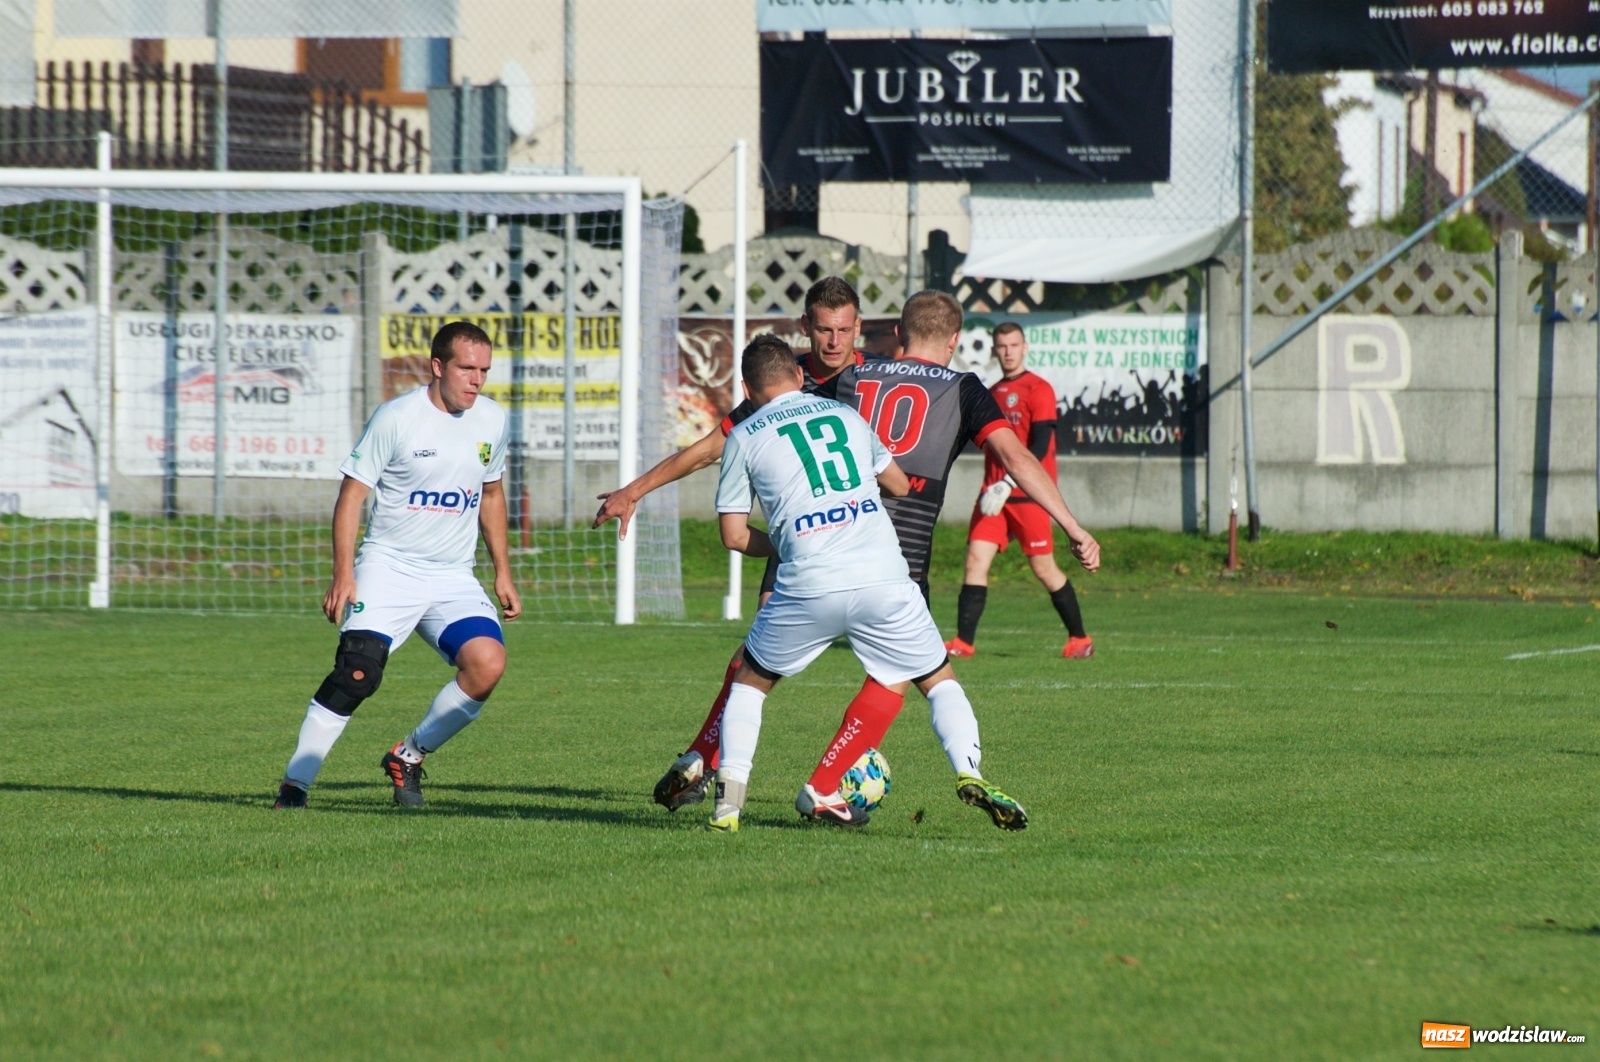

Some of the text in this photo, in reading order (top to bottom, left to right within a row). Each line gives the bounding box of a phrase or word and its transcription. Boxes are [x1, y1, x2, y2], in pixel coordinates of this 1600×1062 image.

[1368, 0, 1545, 20] Krzysztof: 605 083 762
[1450, 31, 1600, 56] www.fiolka.c
[918, 111, 1007, 127] POŚPIECH
[1029, 328, 1199, 347] DEN ZA WSZYSTKICH
[173, 344, 299, 364] CIESELSKIE
[1027, 350, 1196, 369] SZYSCY ZA JEDNEGO
[1316, 313, 1412, 465] R
[745, 418, 767, 436] LKS
[766, 403, 813, 425] POLONIA
[852, 379, 930, 457] 10
[1072, 419, 1186, 444] TWORKÓW
[239, 436, 277, 454] 196
[285, 437, 326, 456] 012
[776, 414, 862, 499] 13
[408, 485, 480, 519] moya
[794, 498, 879, 533] moya
